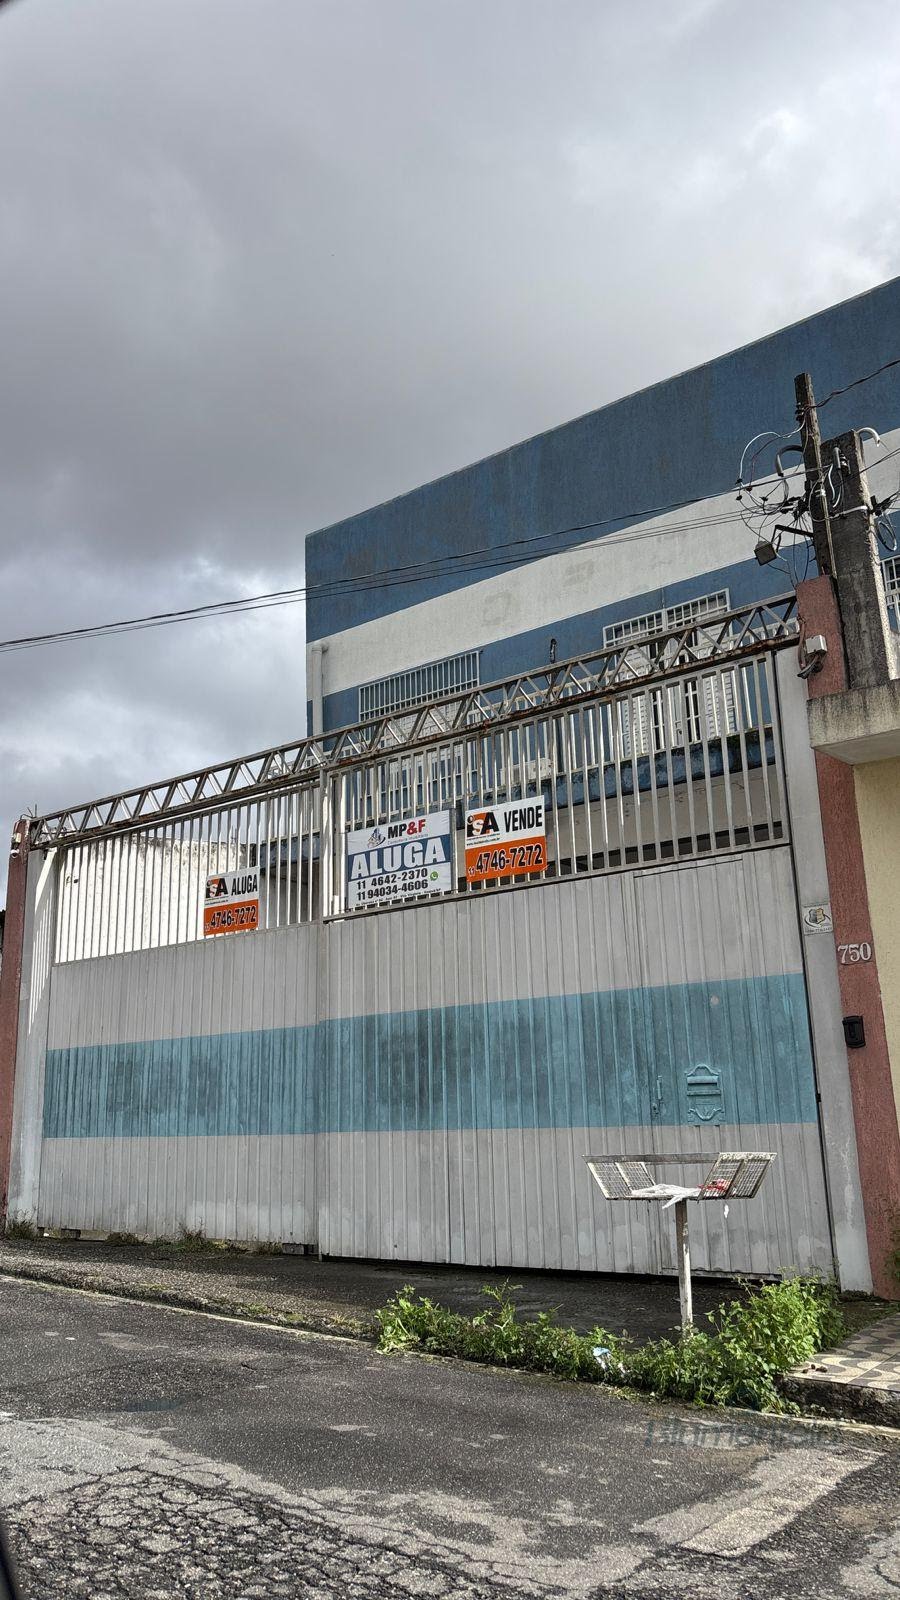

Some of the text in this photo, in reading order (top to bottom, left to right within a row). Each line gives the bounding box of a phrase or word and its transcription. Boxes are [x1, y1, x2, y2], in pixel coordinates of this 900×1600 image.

[387, 819, 426, 839] MP&F
[504, 805, 543, 833] VENDE
[350, 837, 446, 880] ALUGA
[476, 843, 543, 874] 4746-7272
[231, 874, 258, 896] ALUGA
[357, 868, 428, 890] 11 4642-2370
[357, 891, 366, 901] 11
[367, 879, 428, 899] 94034-4606
[210, 905, 256, 929] 4746-7272
[837, 942, 872, 964] 750
